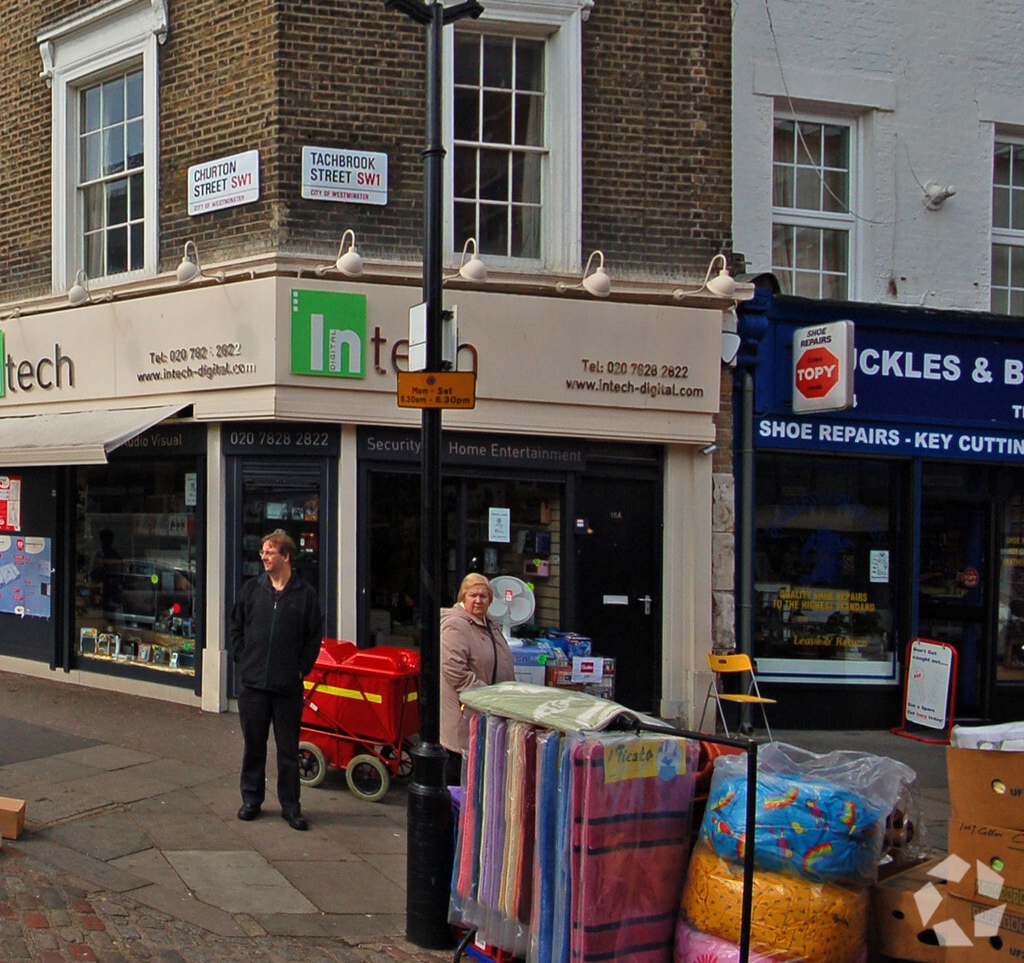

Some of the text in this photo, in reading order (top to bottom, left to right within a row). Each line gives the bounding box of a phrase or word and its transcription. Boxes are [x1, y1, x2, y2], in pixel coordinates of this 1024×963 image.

[310, 152, 376, 170] TACHBROOK
[194, 161, 236, 183] CHURTON
[310, 169, 380, 186] STREET SW1
[194, 173, 252, 197] STREET SW1
[212, 195, 244, 208] WESTMINSTER
[332, 191, 369, 200] WESTMINSTER
[807, 327, 827, 337] SHOE
[800, 335, 832, 347] REPAIRS
[150, 351, 168, 363] Tel:
[170, 349, 187, 362] 020
[137, 363, 256, 382] www.intech-digital.com
[582, 359, 688, 378] Tel: 020 7828 2822
[797, 365, 836, 381] TOPY
[854, 348, 961, 381] CKLES
[972, 357, 993, 383] &
[566, 379, 704, 397] www.intech-digital.com
[436, 396, 470, 404] 6.30pm
[126, 433, 182, 446] udio Visual
[230, 432, 329, 446] 020 7828 2822
[759, 420, 812, 439] SHOE
[819, 425, 900, 446] REPAIRS
[914, 432, 954, 450] KEY
[367, 437, 581, 461] Security Home Entertainment
[780, 590, 812, 599] QUALITY
[835, 592, 868, 602] REPAIRS
[772, 599, 875, 612] TO THE HIGHEST STANDARD
[794, 636, 823, 646] Leave
[836, 637, 868, 647] Return
